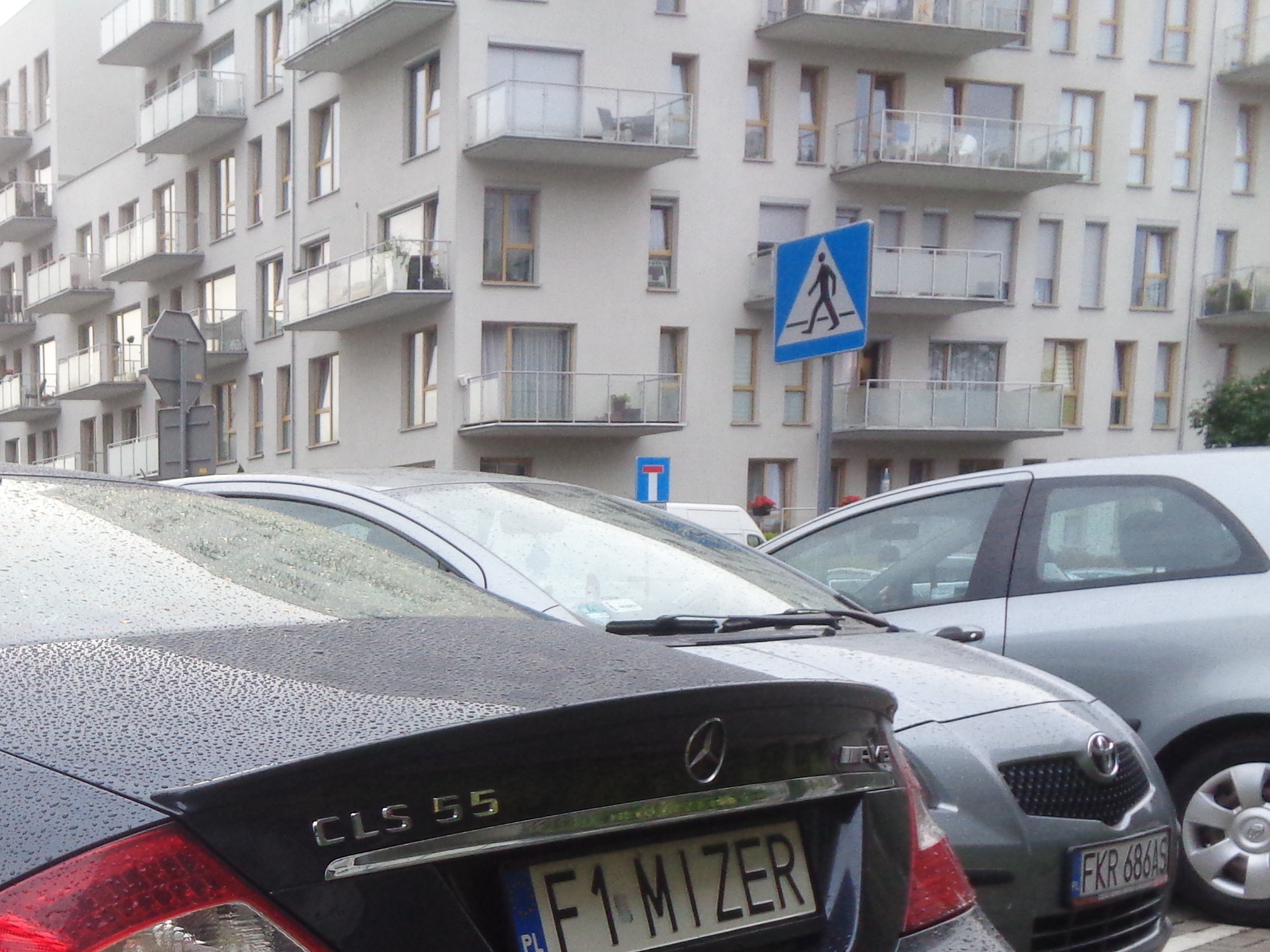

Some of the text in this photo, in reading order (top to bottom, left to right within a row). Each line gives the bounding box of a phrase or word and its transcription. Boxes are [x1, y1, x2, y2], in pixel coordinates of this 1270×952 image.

[312, 789, 499, 847] CLS 55
[1082, 848, 1118, 893] FKR
